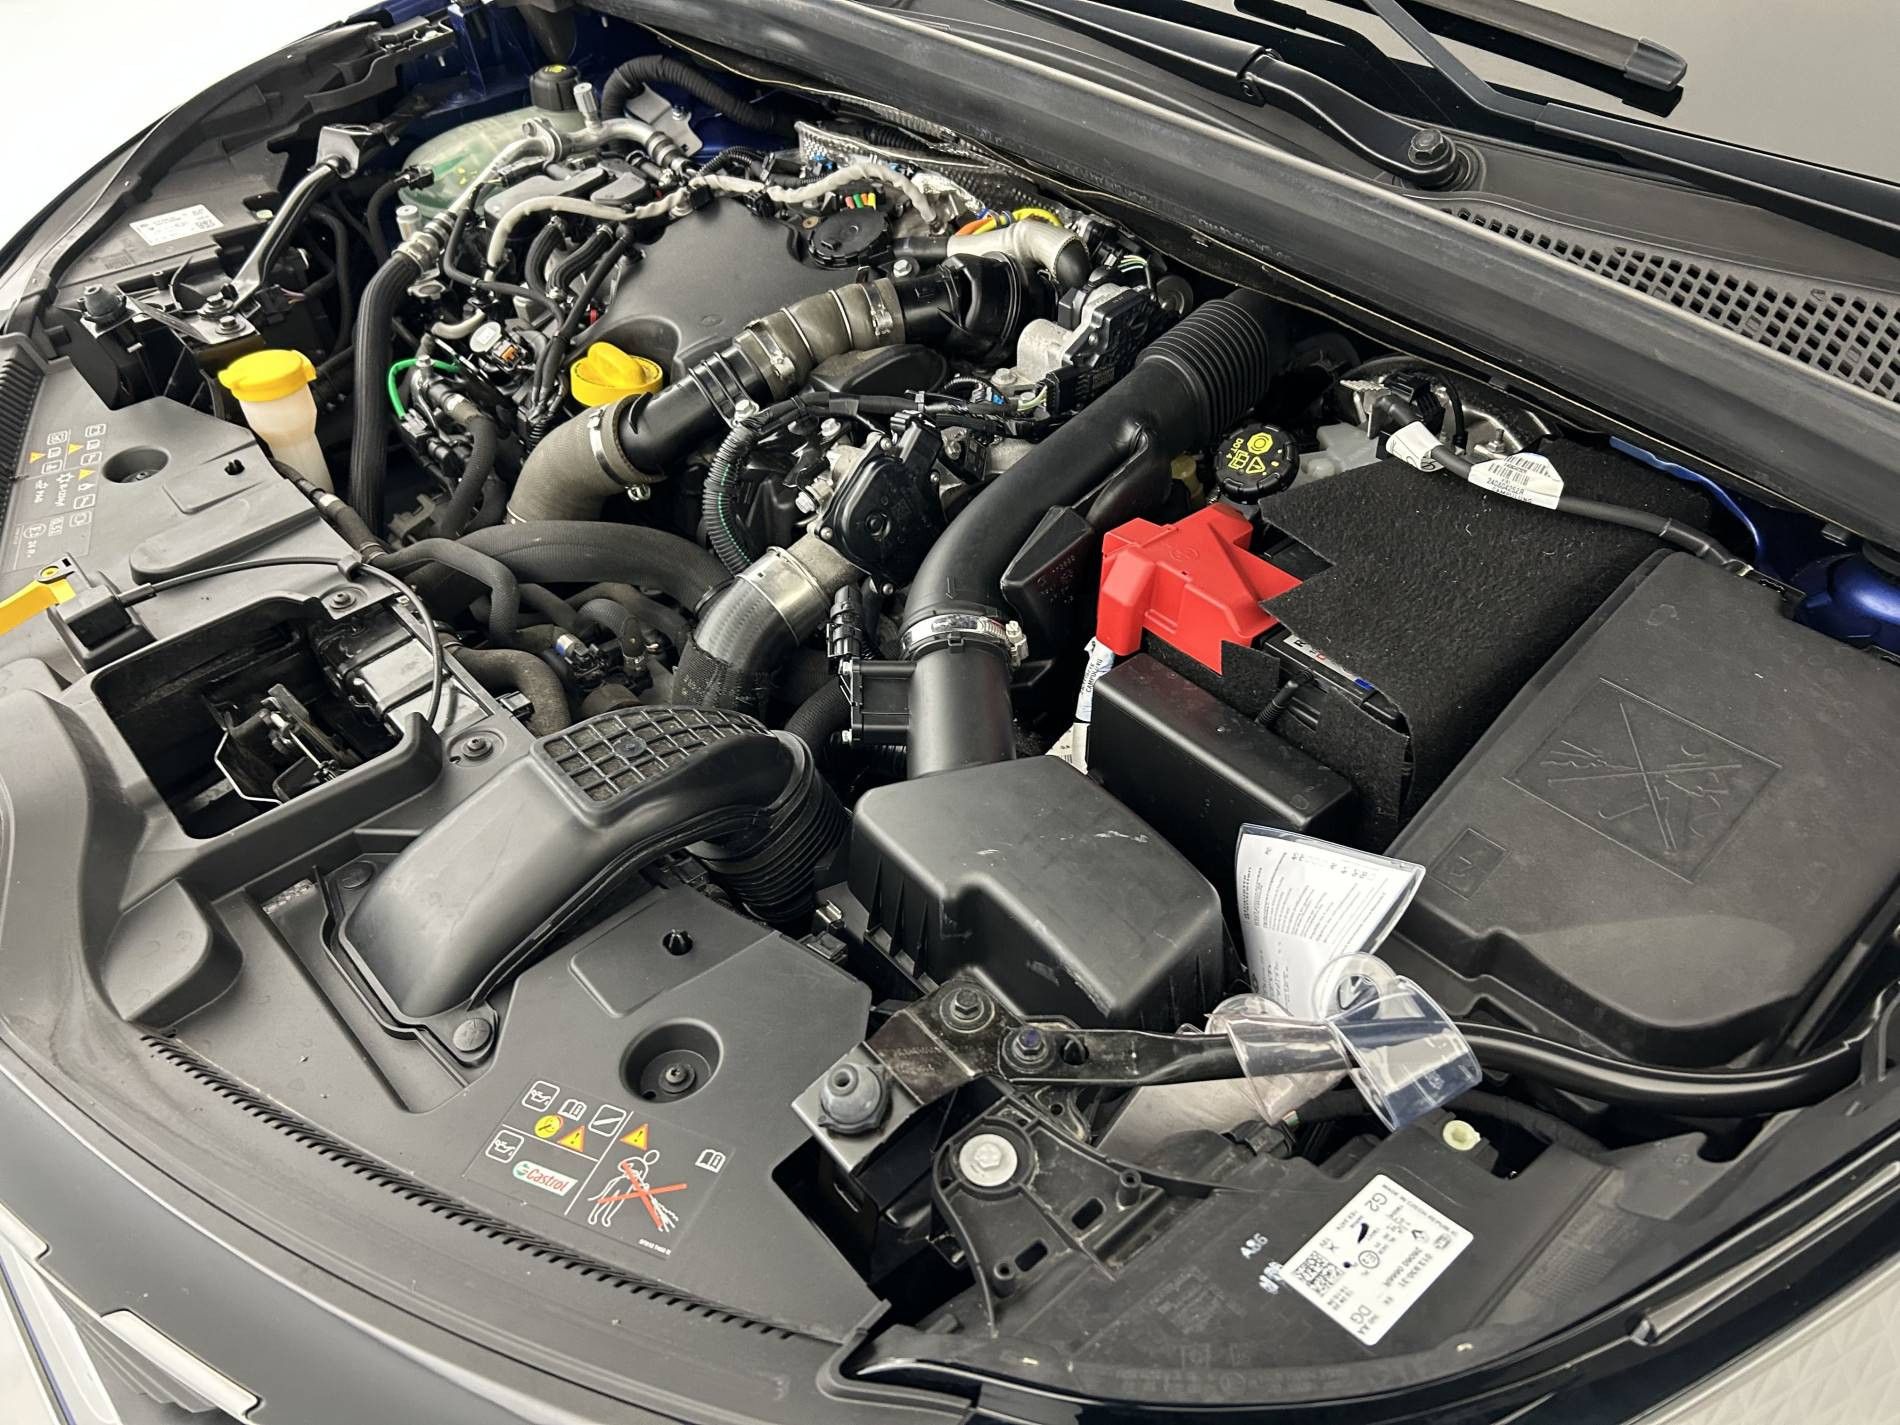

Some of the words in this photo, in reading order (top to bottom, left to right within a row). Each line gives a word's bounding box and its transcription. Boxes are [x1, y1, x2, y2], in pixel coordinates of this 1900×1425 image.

[1231, 438, 1244, 453] DOT
[526, 1169, 570, 1193] Castrol
[1365, 1191, 1388, 1212] G2
[1350, 1303, 1373, 1324] DG
